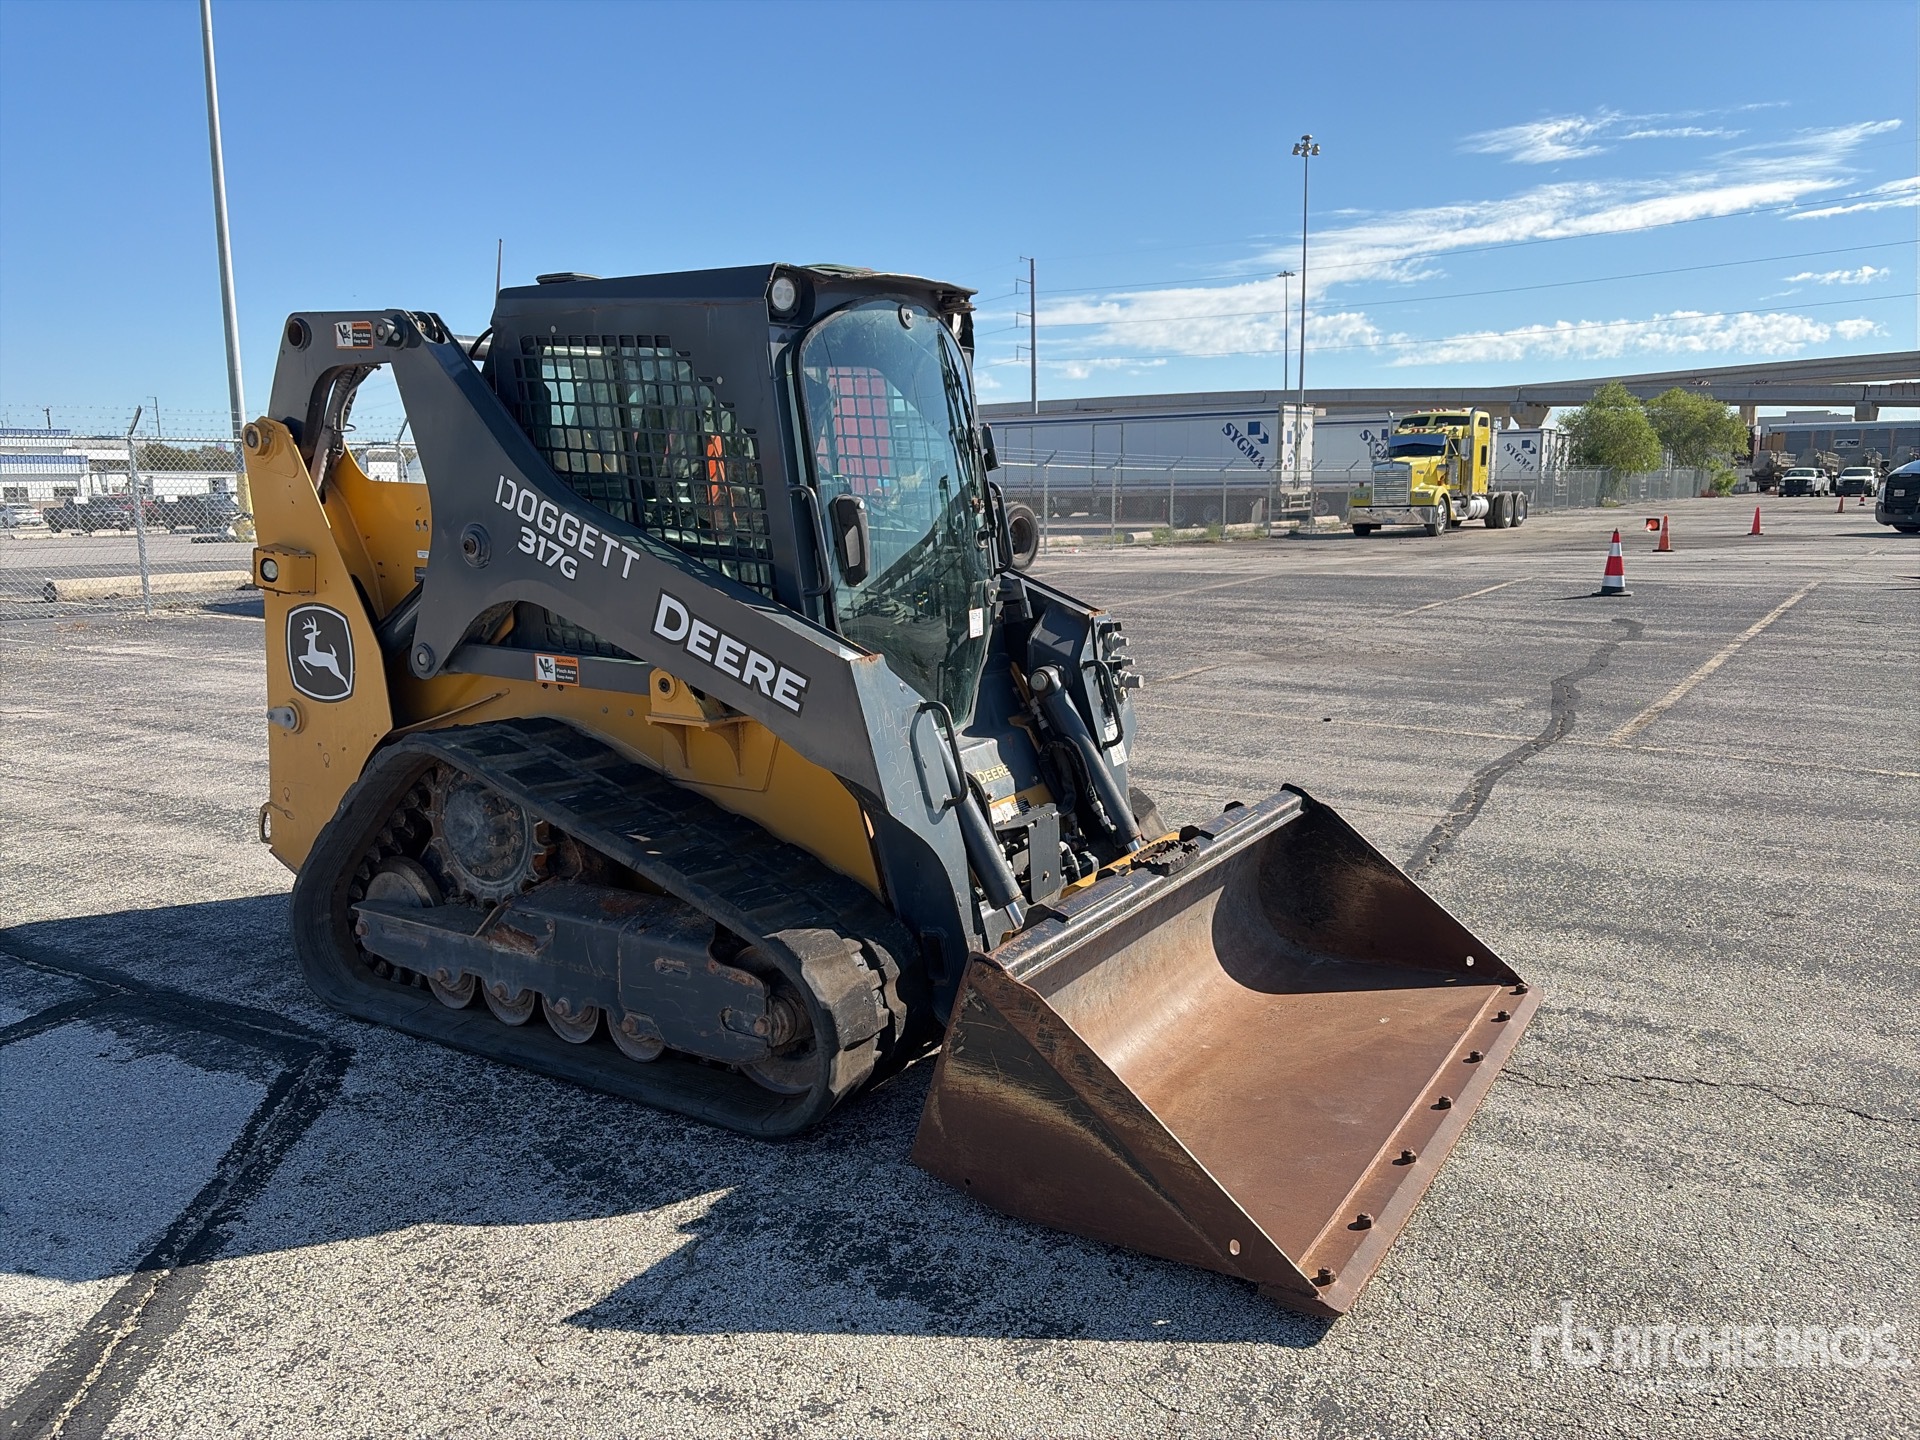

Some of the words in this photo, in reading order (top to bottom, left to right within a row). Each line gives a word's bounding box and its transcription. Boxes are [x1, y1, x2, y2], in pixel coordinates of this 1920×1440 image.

[1222, 422, 1265, 469] SYGMA
[1503, 443, 1534, 472] SYGMA
[495, 475, 640, 579] DOGGETT
[517, 526, 578, 580] 317G
[653, 593, 807, 712] DEERE
[976, 764, 1010, 785] DEERE
